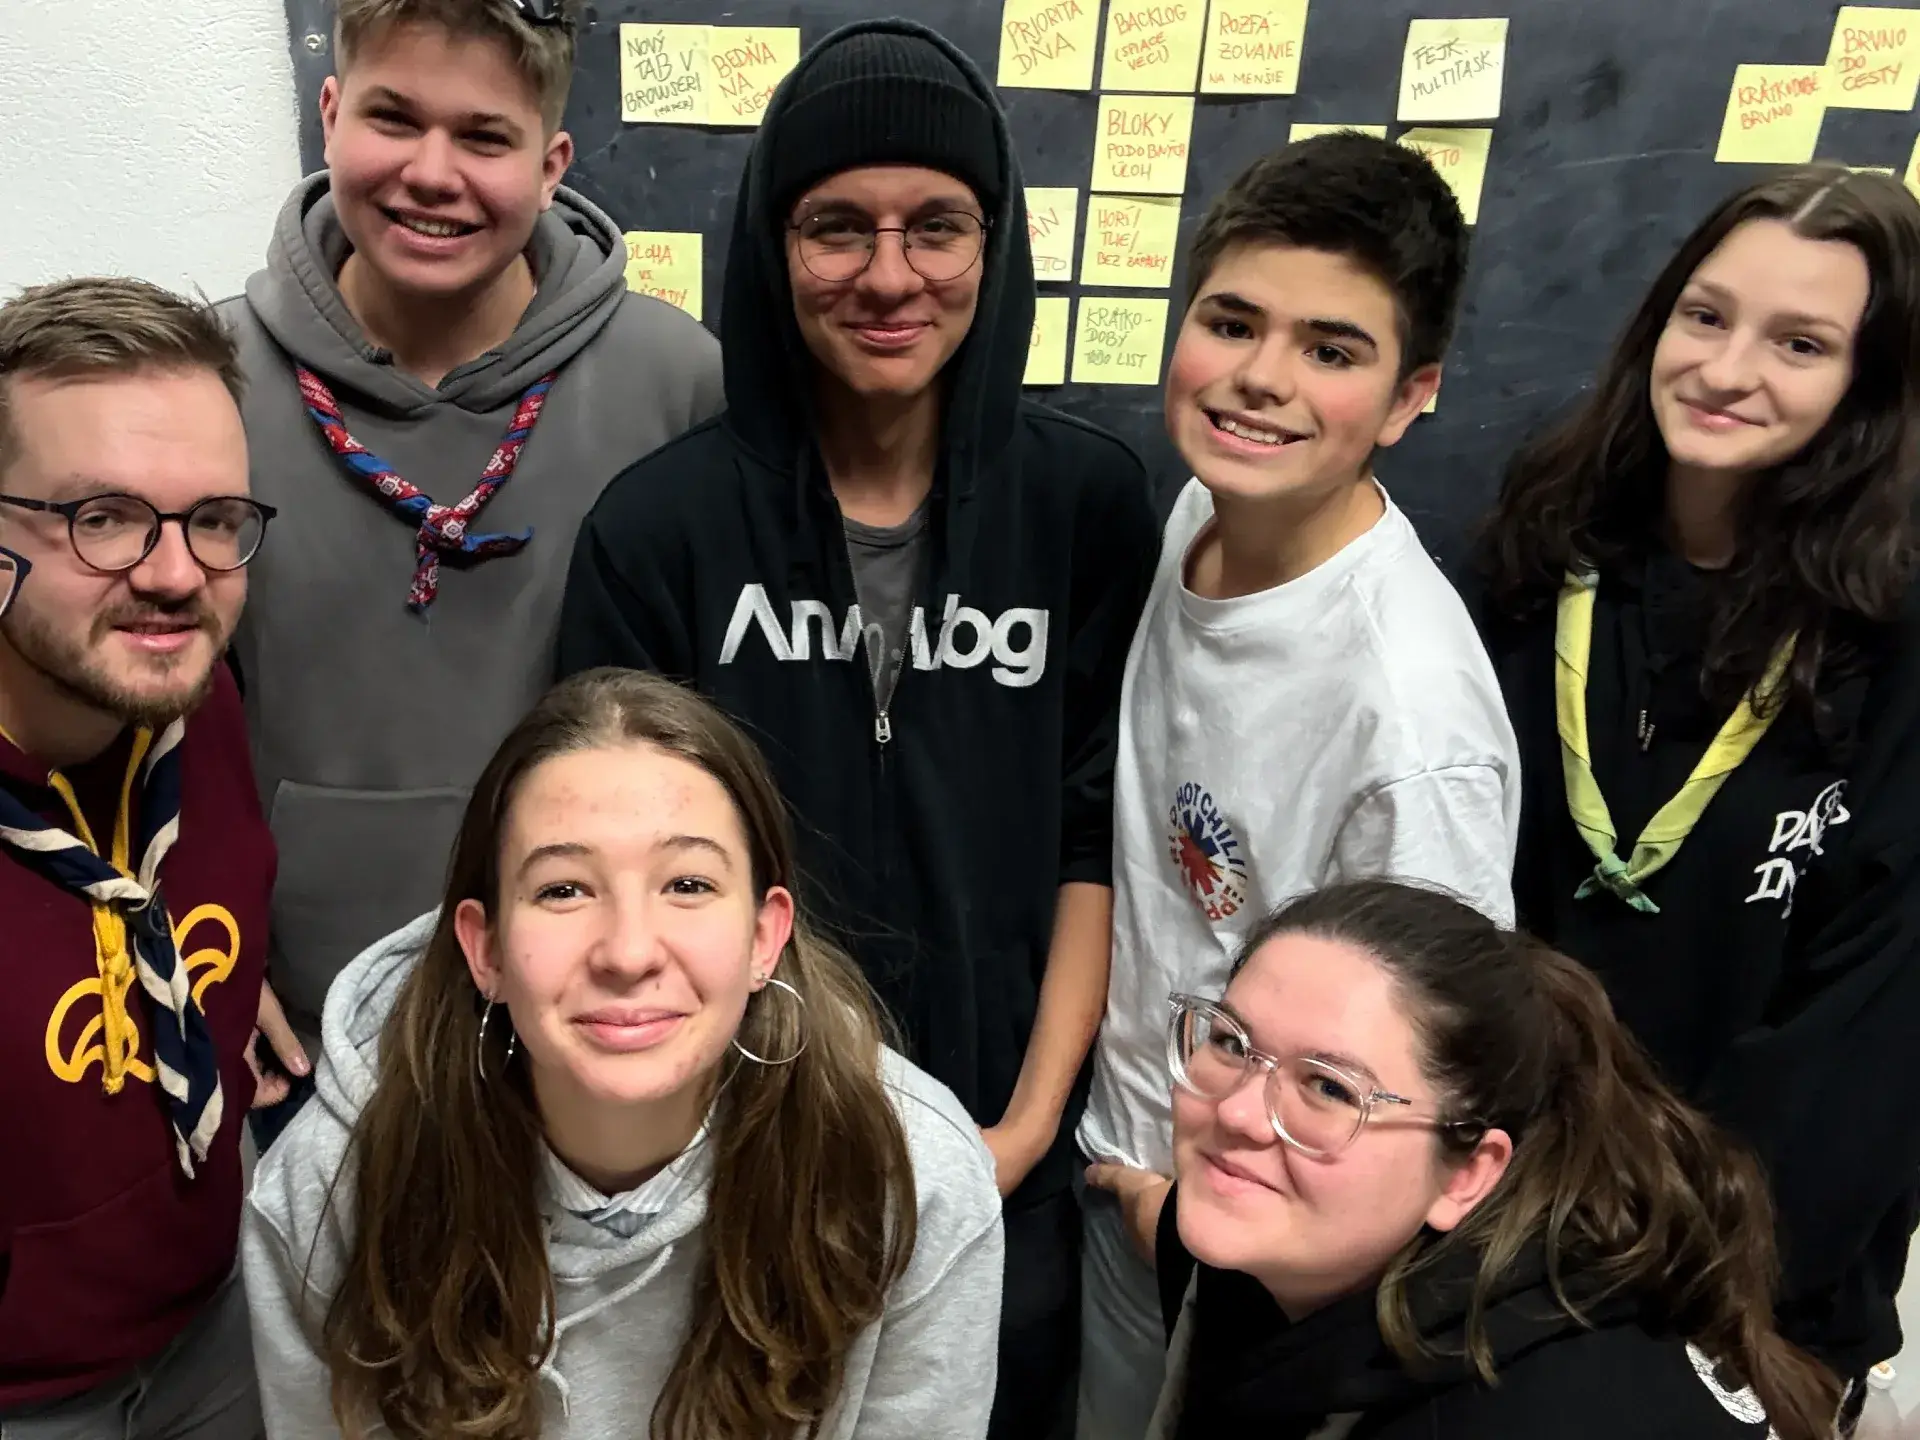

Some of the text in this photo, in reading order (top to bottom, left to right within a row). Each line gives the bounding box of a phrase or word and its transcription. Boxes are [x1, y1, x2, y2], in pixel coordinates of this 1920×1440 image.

[1006, 0, 1084, 52] PRIORITA
[1114, 4, 1187, 35] BACKLOG
[626, 29, 665, 57] NOVÝ
[711, 36, 777, 78] BEDŇA
[1218, 40, 1295, 61] ZOVANIE
[634, 49, 694, 82] TAB V
[1209, 72, 1225, 84] NA
[1838, 55, 1867, 74] DO
[1842, 61, 1903, 91] CESTY
[625, 72, 702, 112] BROWSERI
[719, 72, 755, 98] NA
[1107, 109, 1174, 137] BLOKY
[1097, 251, 1121, 268] BEZ
[1116, 353, 1148, 368] LIST
[1176, 781, 1202, 812] HOT
